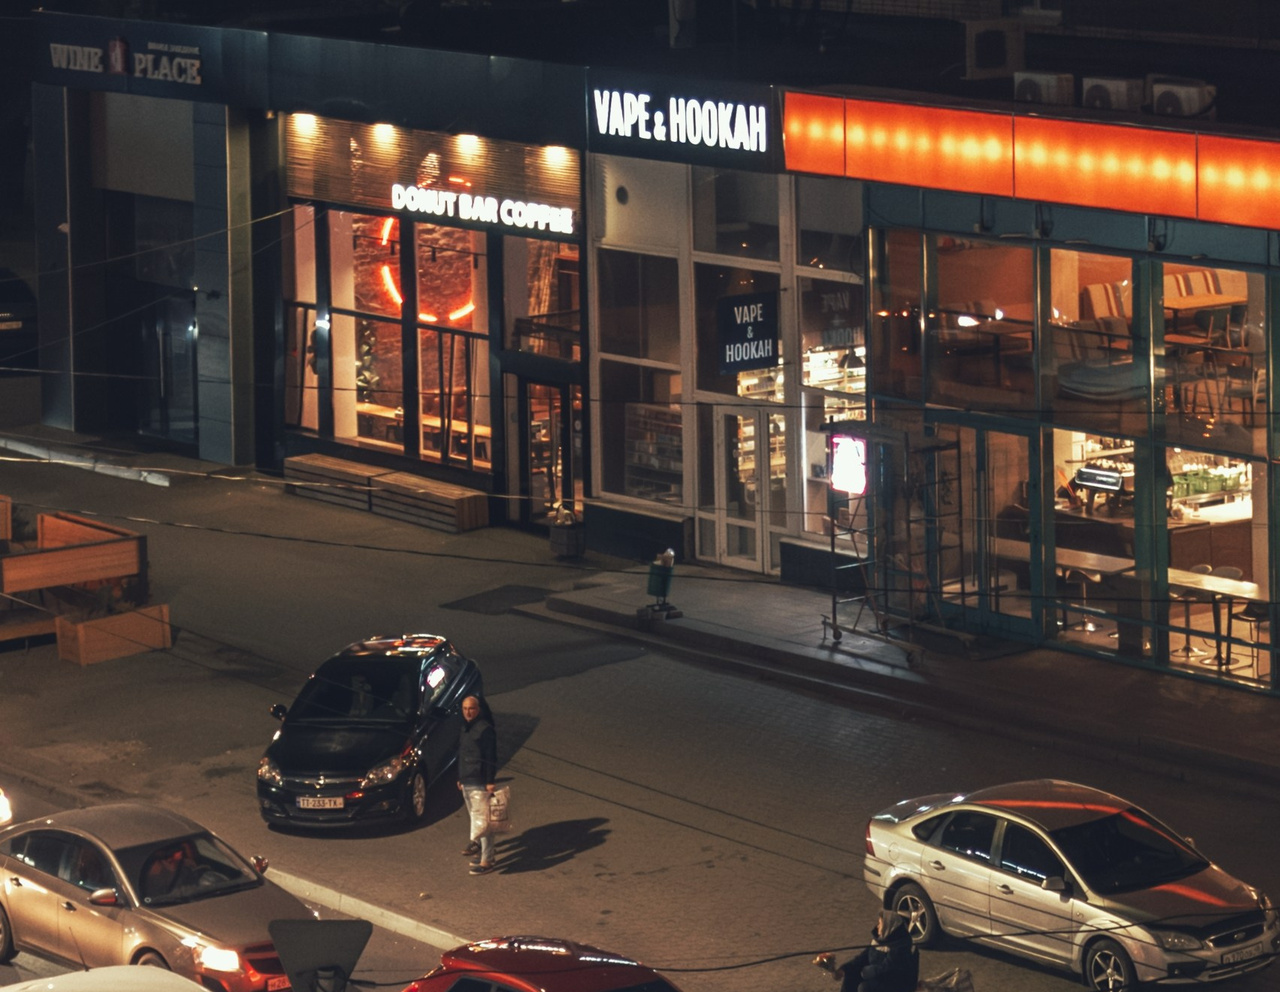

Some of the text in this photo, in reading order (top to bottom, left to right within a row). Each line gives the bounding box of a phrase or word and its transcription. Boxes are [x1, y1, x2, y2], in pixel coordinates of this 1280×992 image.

[50, 43, 202, 85] WINE PLACE
[593, 89, 767, 153] VAPE & HOOKAH
[391, 183, 574, 235] DONUT BAR COFFEE
[734, 303, 763, 325] VAPE
[746, 325, 754, 339] &
[725, 338, 773, 363] HOOKAH
